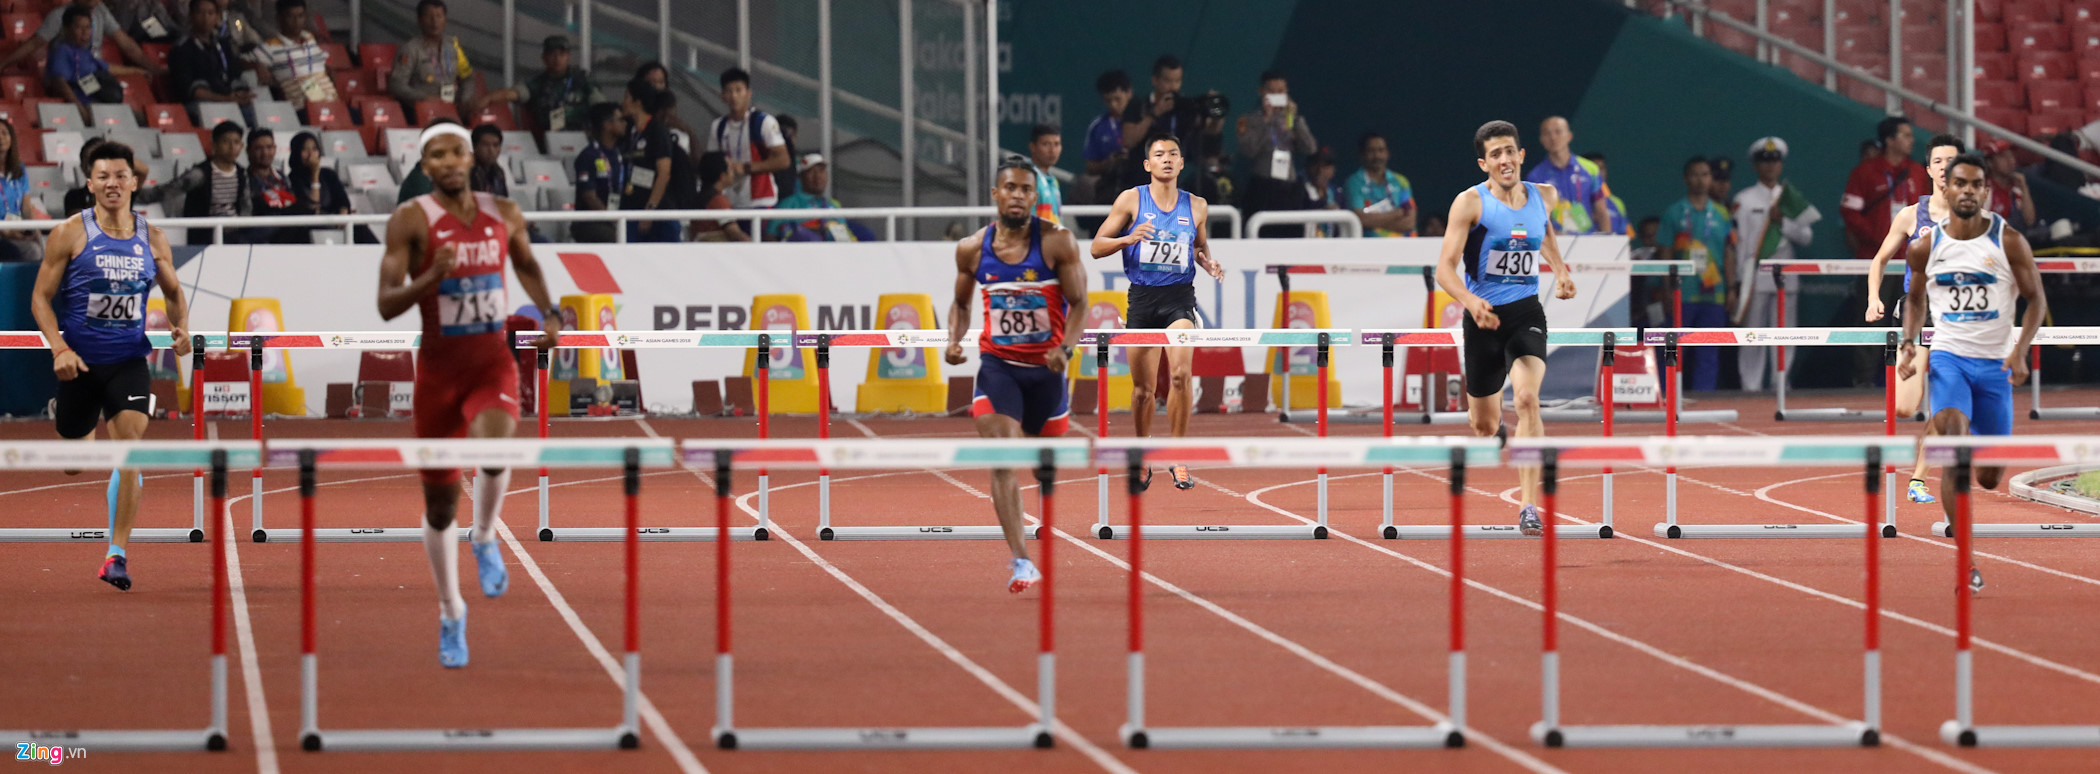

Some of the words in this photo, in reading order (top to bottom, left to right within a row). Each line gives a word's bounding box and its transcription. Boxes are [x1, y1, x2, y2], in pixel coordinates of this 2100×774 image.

[95, 254, 145, 271] CHINESE
[445, 239, 501, 268] ATAR
[1149, 241, 1182, 265] 792
[1495, 251, 1533, 275] 430
[102, 267, 139, 282] TAIPEI
[96, 294, 136, 319] 260
[450, 291, 497, 325] 713
[1948, 285, 1989, 312] 323
[999, 310, 1040, 335] 681
[70, 531, 105, 539] UCS
